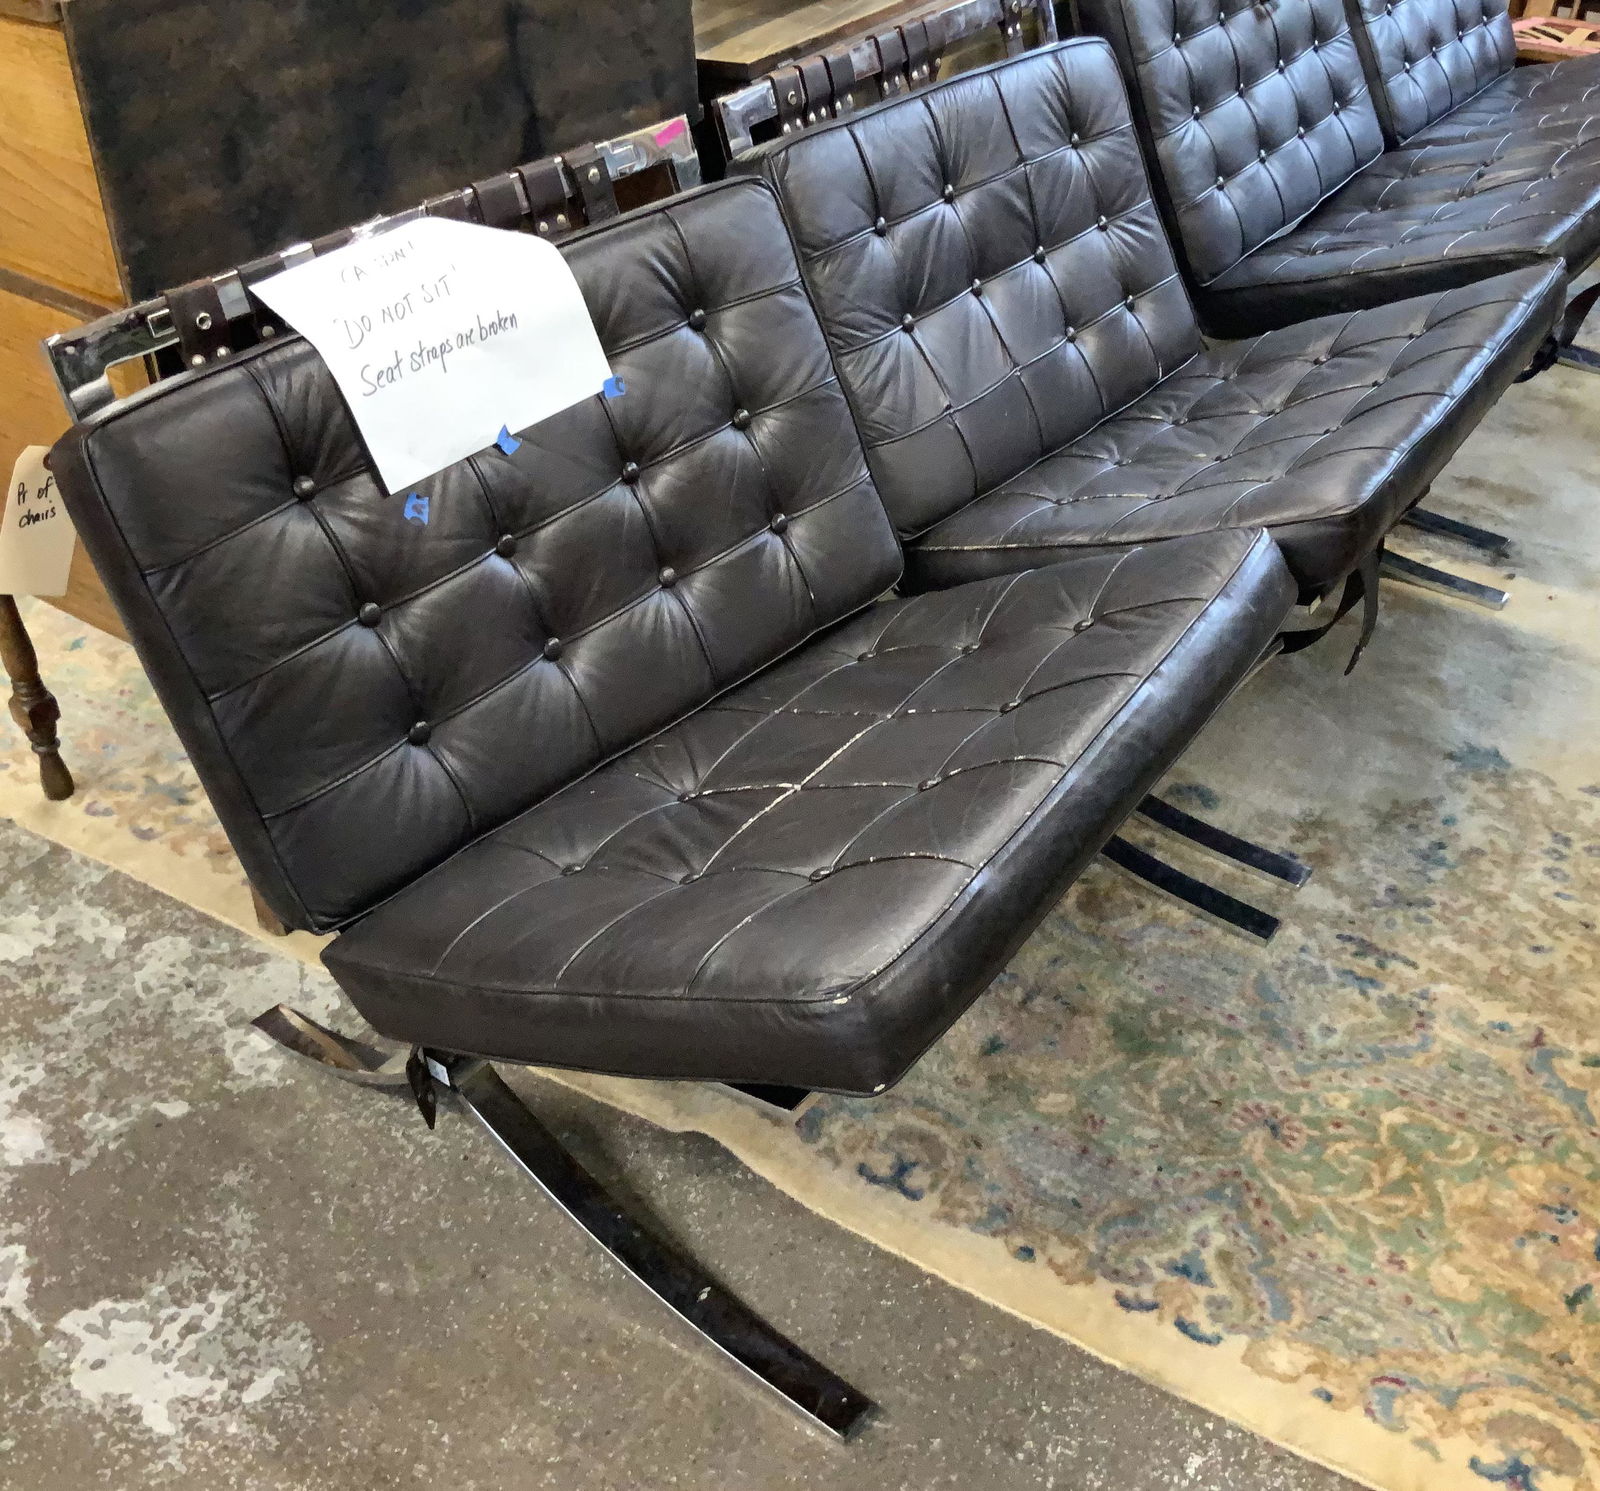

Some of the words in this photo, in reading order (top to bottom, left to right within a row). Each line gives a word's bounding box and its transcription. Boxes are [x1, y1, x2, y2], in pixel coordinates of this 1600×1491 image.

[381, 291, 415, 325] NOT
[361, 350, 404, 397] Seat
[410, 338, 453, 374] straps
[456, 329, 475, 351] are
[477, 309, 518, 342] broken
[36, 476, 54, 500] of
[18, 502, 56, 528] chairs
